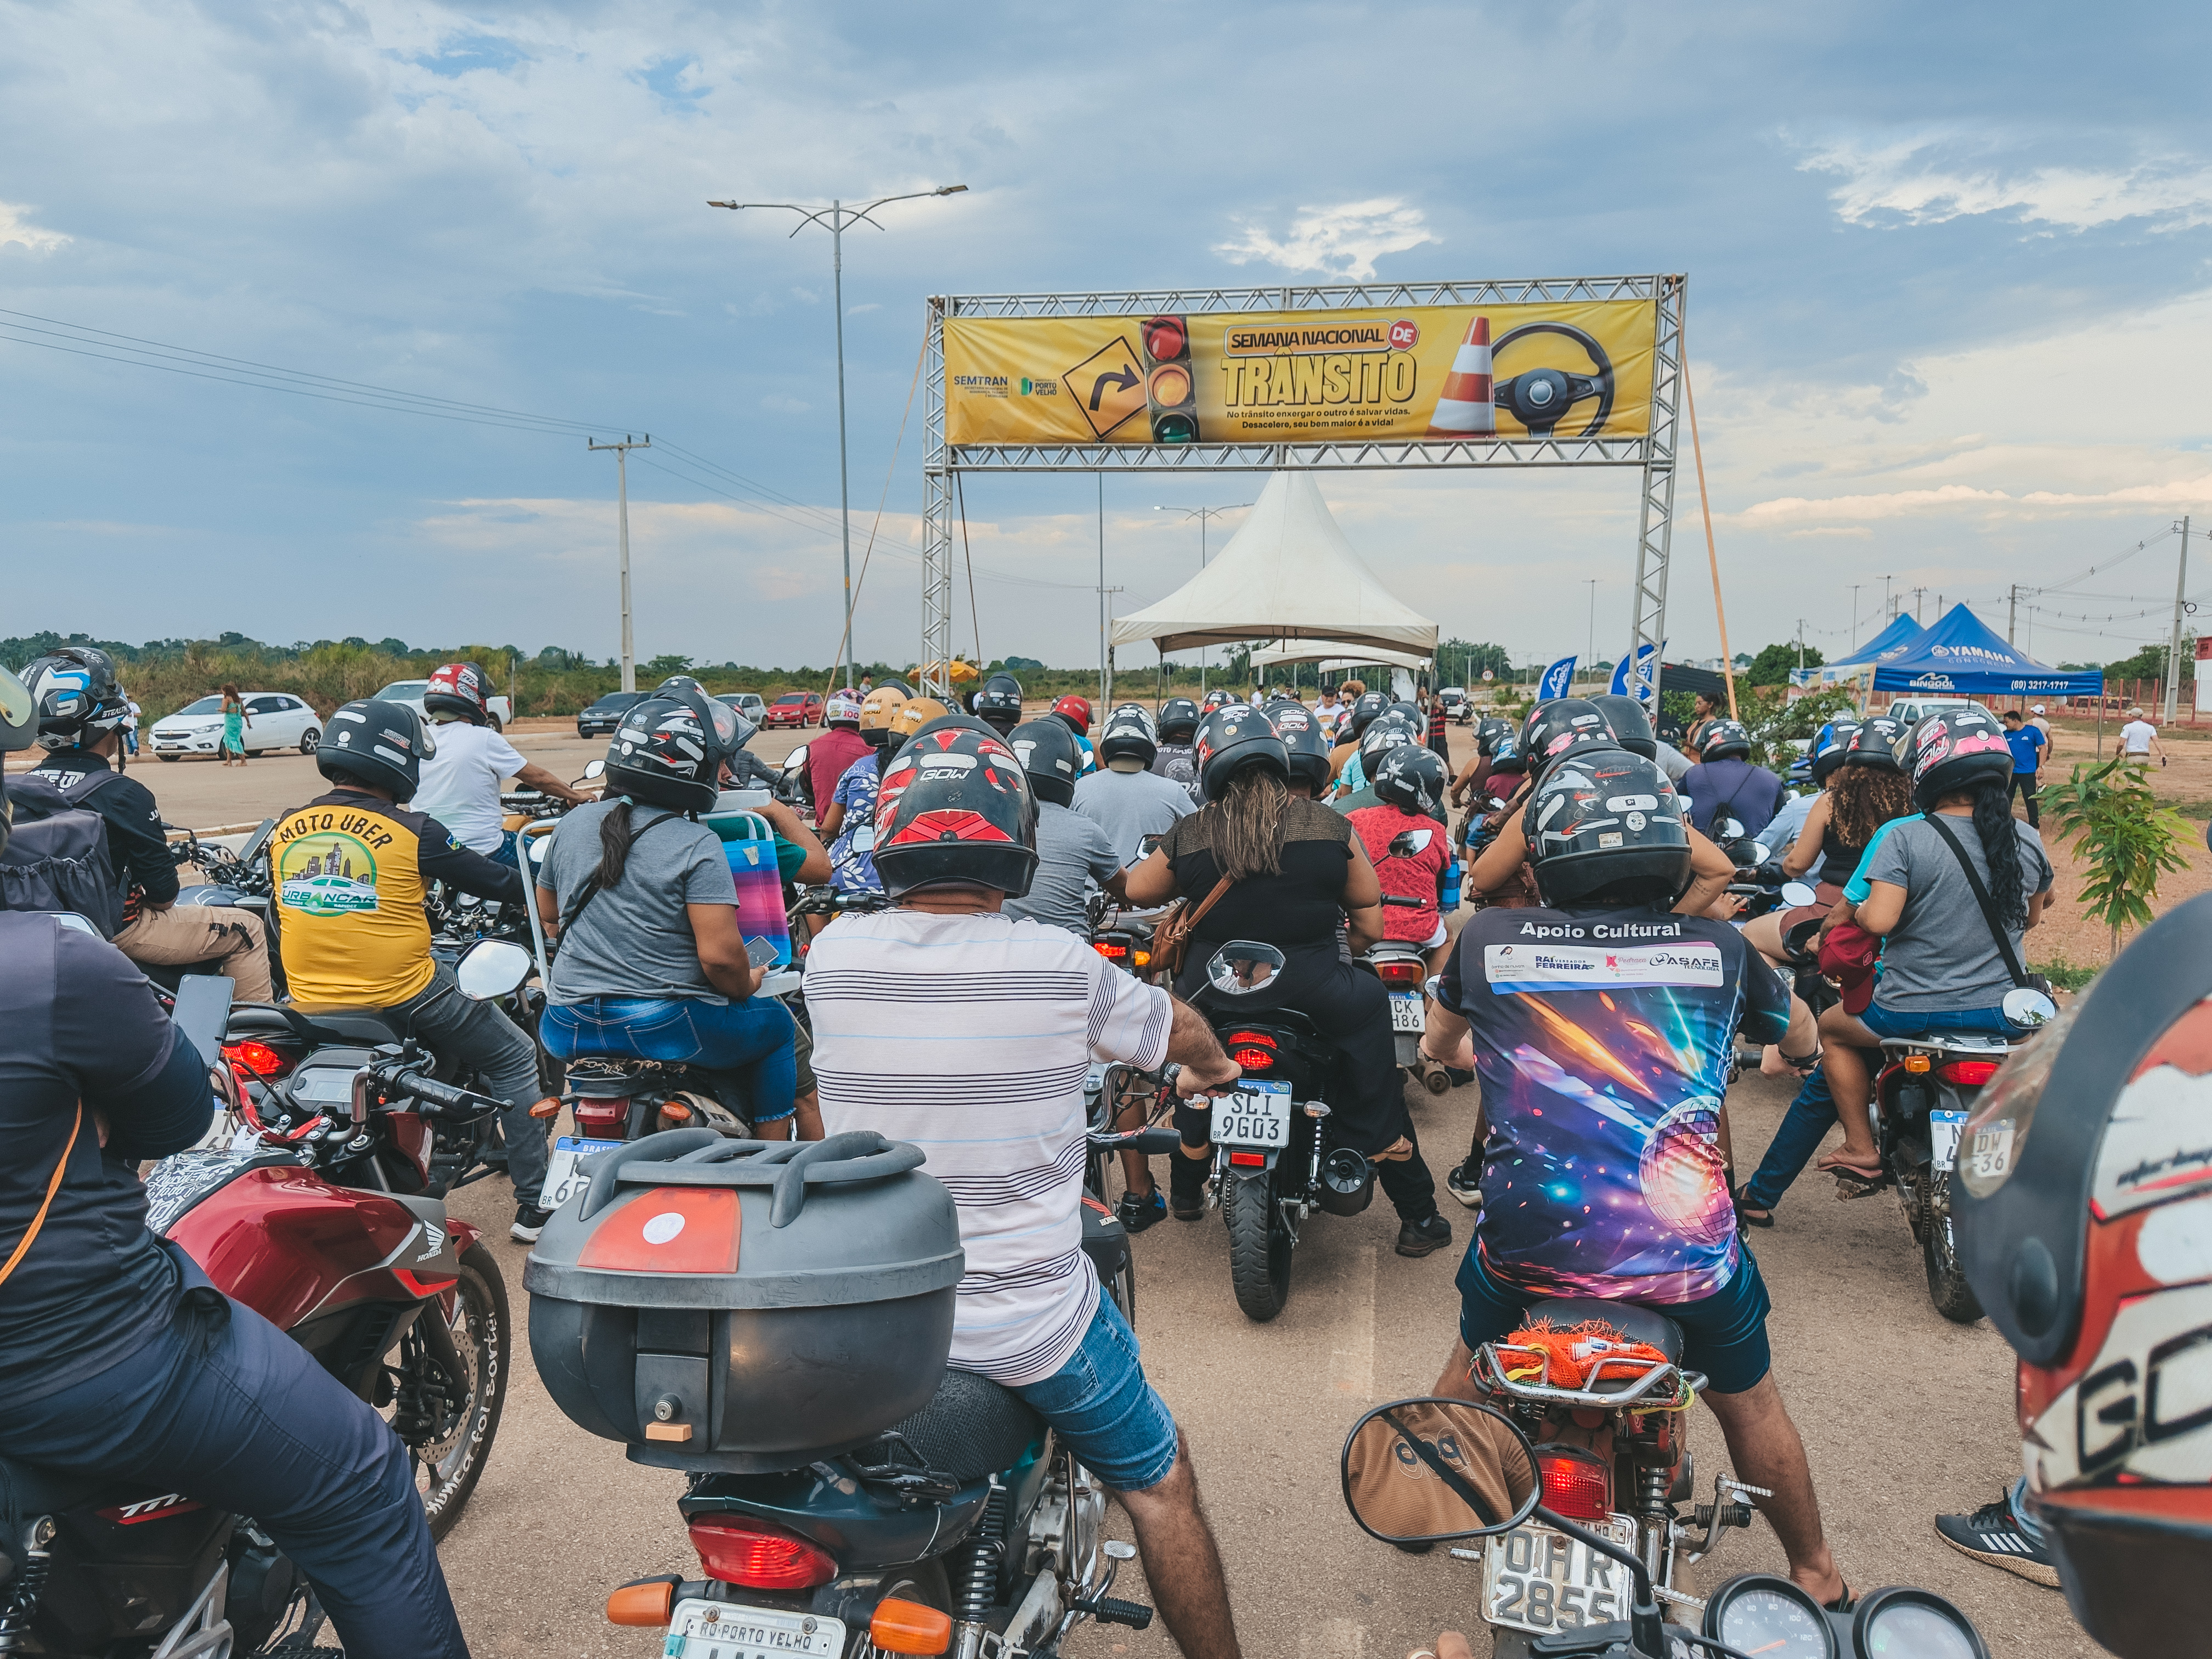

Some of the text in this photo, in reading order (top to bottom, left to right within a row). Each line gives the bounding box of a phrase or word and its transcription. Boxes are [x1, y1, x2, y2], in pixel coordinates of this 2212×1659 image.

[1231, 326, 1412, 348] SEMANA NACIONAL DE
[954, 376, 1008, 386] SEMTRAN
[1221, 346, 1417, 406] TRÂNSITO
[1241, 409, 1274, 418] trânsito
[1276, 410, 1315, 420] enxergar
[1349, 408, 1355, 416] é
[1356, 408, 1383, 416] salvar
[1384, 407, 1410, 415] vidas.
[1242, 420, 1291, 430] Desacelere,
[1310, 420, 1330, 428] bem
[1331, 419, 1357, 427] maior
[1358, 418, 1364, 427] é
[1371, 418, 1394, 427] vida!
[1949, 646, 2016, 665] YAMAHA
[2028, 680, 2069, 691] 3217-1717
[101, 705, 127, 718] STEALTH
[1279, 722, 1307, 730] GOW
[919, 769, 970, 781] GOW
[280, 814, 393, 851] MOTO UBER
[1519, 922, 1681, 939] Apoio Cultural
[1667, 957, 1719, 968] ASAFE
[1393, 1000, 1413, 1014] CK
[1231, 1093, 1272, 1116] SLI
[1222, 1115, 1280, 1140] 9G03
[1212, 1130, 1221, 1139] BR
[1936, 1160, 1946, 1169] BR
[541, 1195, 552, 1206] BR
[416, 1247, 443, 1262] HONDA
[721, 1624, 763, 1644] PORTO
[770, 1632, 812, 1650] VELHO
